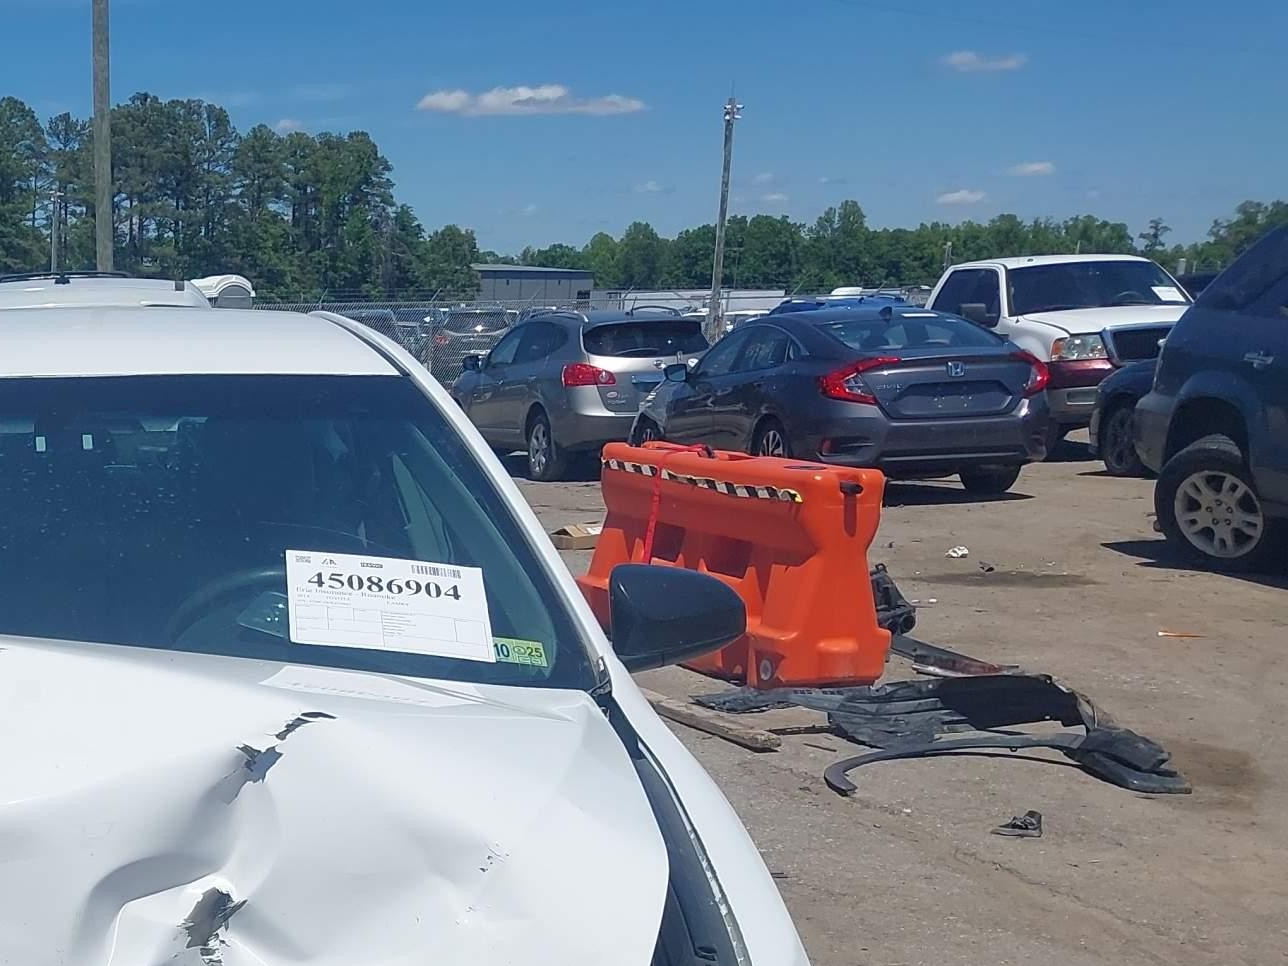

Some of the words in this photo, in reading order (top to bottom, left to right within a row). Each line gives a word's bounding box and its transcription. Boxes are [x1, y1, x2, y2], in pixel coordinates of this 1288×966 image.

[307, 572, 462, 601] 45086904
[493, 643, 510, 658] 10
[526, 646, 543, 658] 25
